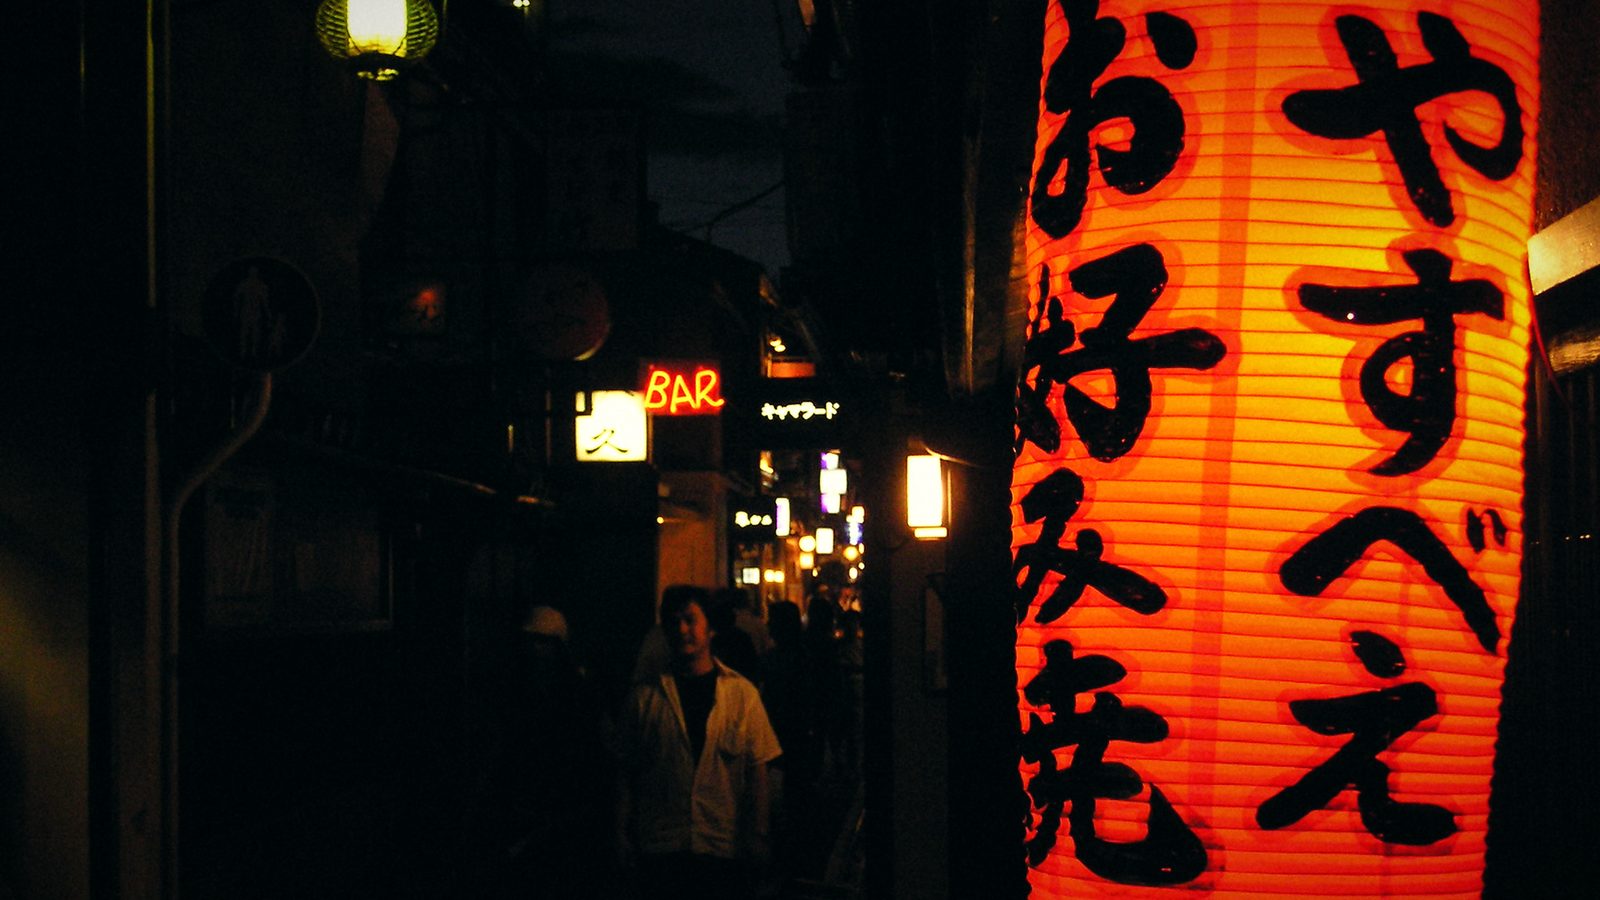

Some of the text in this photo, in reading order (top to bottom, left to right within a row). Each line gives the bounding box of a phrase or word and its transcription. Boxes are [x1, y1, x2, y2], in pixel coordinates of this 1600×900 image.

[644, 369, 725, 413] BAR
[1013, 0, 1227, 886] お好み焼
[1256, 10, 1524, 846] やすべえ
